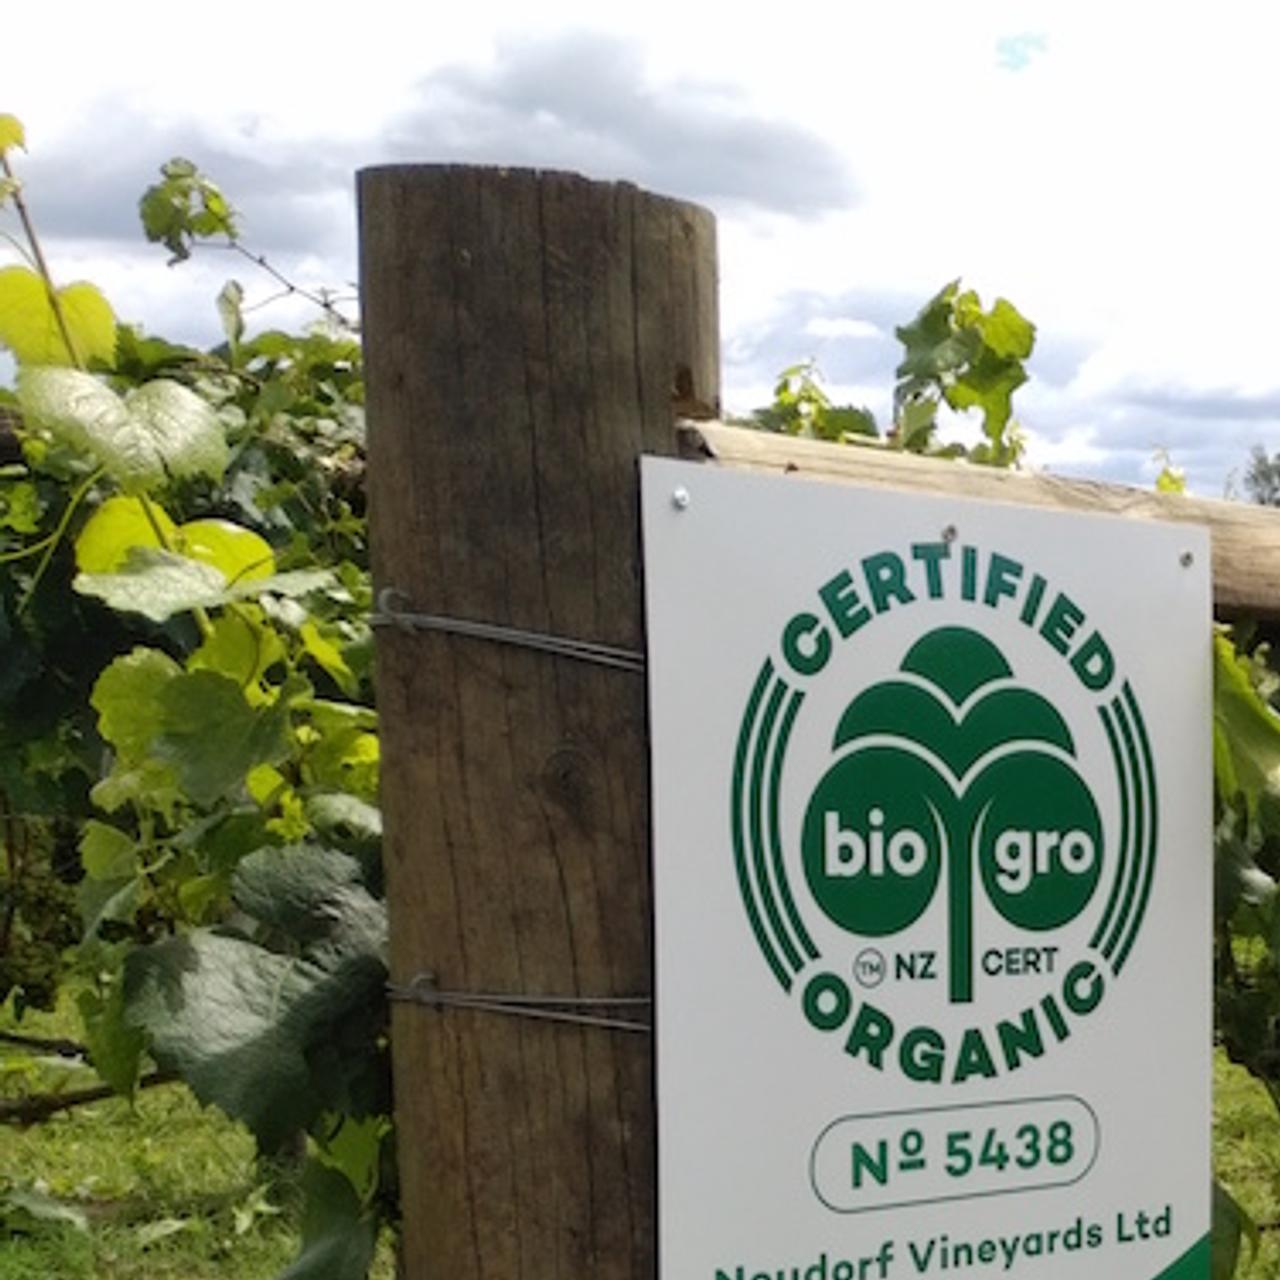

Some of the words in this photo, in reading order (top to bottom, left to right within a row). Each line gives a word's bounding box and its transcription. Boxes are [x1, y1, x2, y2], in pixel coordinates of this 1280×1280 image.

[781, 542, 1115, 692] CERTIFIED
[824, 809, 927, 876] bio
[995, 828, 1095, 893] gro
[895, 952, 937, 980] NZ
[982, 947, 1059, 975] CERT
[802, 959, 1104, 1084] ORGANIC
[944, 1120, 1075, 1177] 5438
[908, 1217, 1103, 1273] Vineyards
[1117, 1206, 1173, 1243] Ltd
